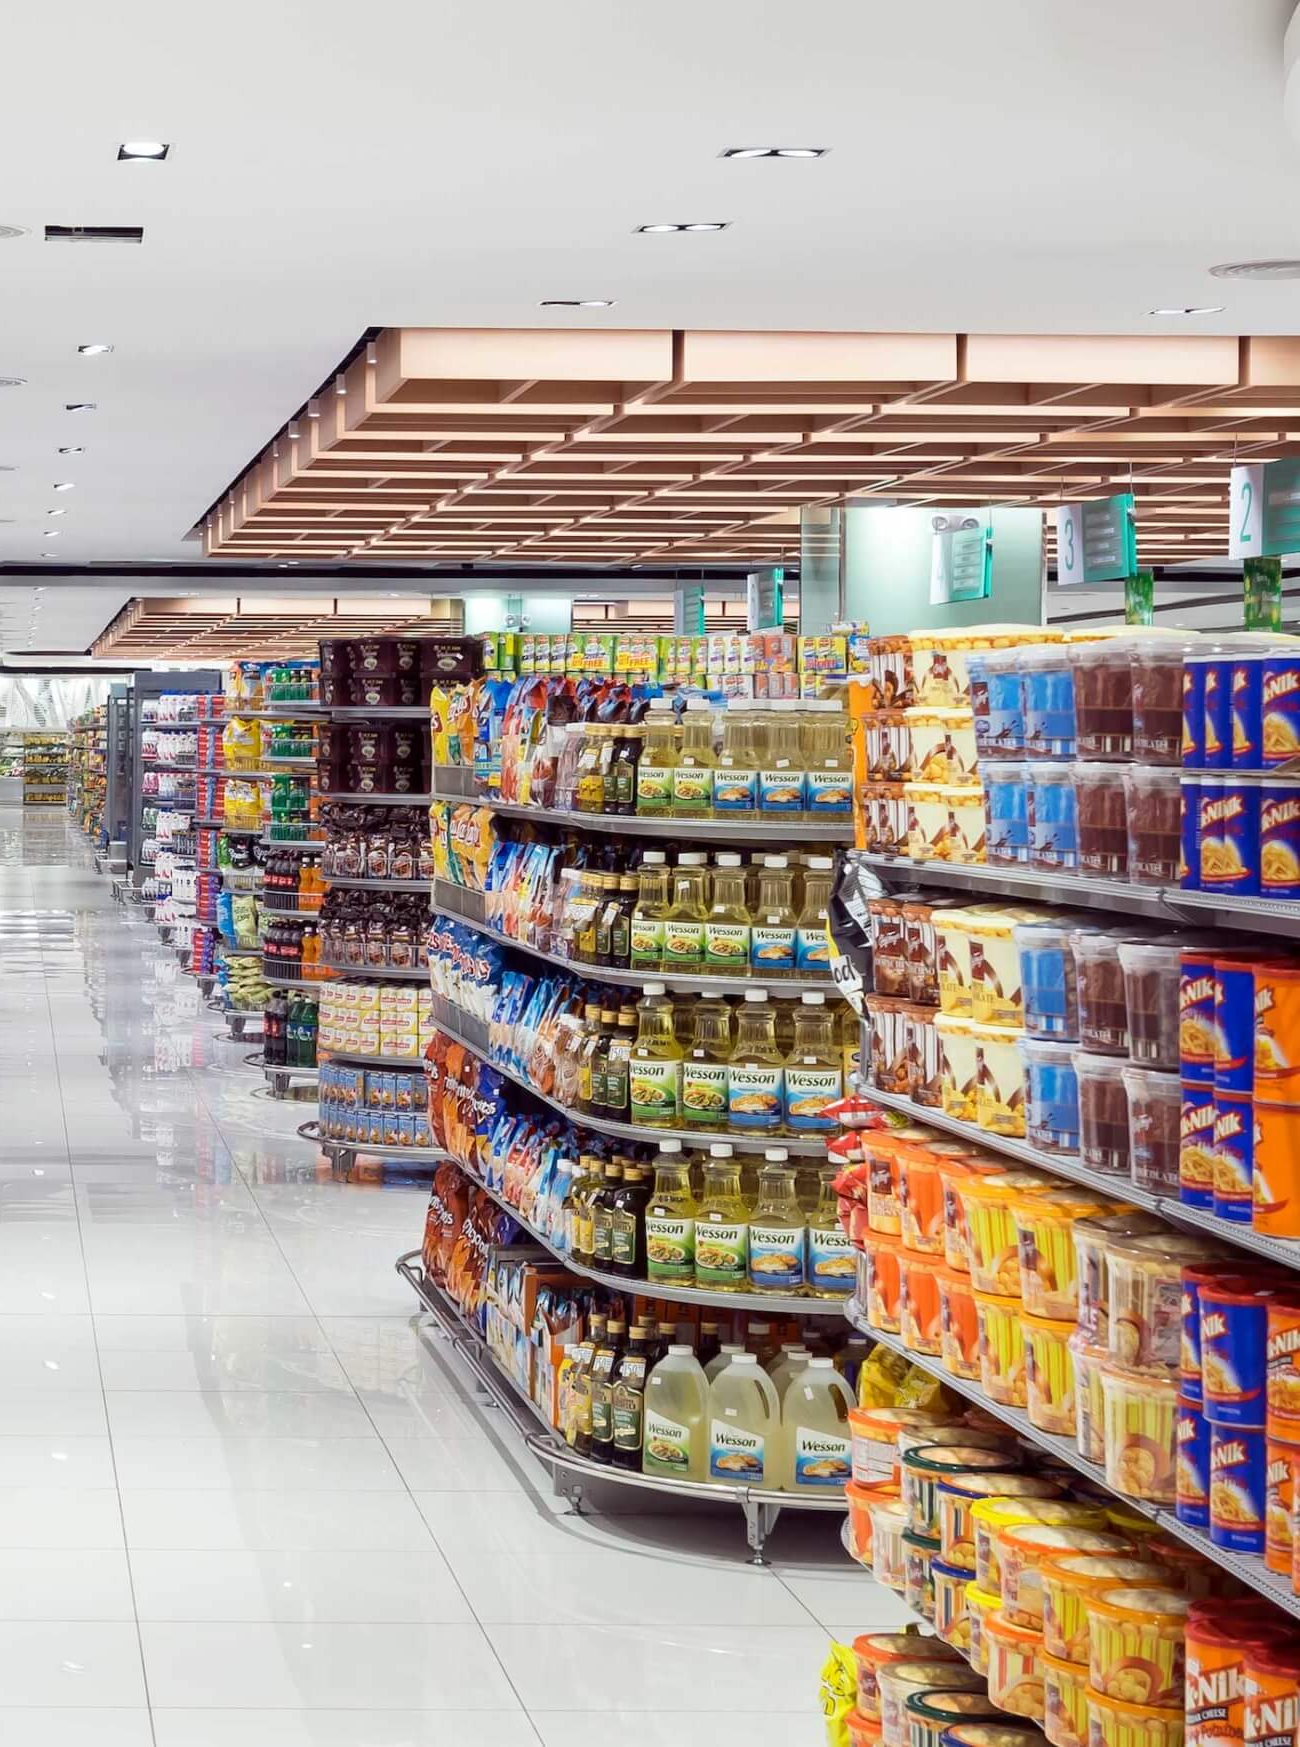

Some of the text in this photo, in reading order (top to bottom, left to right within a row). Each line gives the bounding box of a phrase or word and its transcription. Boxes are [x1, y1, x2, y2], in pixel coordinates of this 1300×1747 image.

[1240, 483, 1252, 543] 2
[1064, 519, 1074, 571] 3
[716, 772, 750, 783] Wesson
[764, 773, 800, 784] Wesson
[814, 774, 849, 784] Wesson
[667, 924, 700, 934] Wesson
[709, 926, 743, 936] Wesson
[756, 930, 792, 940] Wesson
[787, 1073, 836, 1087] Wesson
[649, 1422, 683, 1439] Wesson
[716, 1431, 757, 1448] Wesson
[802, 1439, 846, 1453] Wesson
